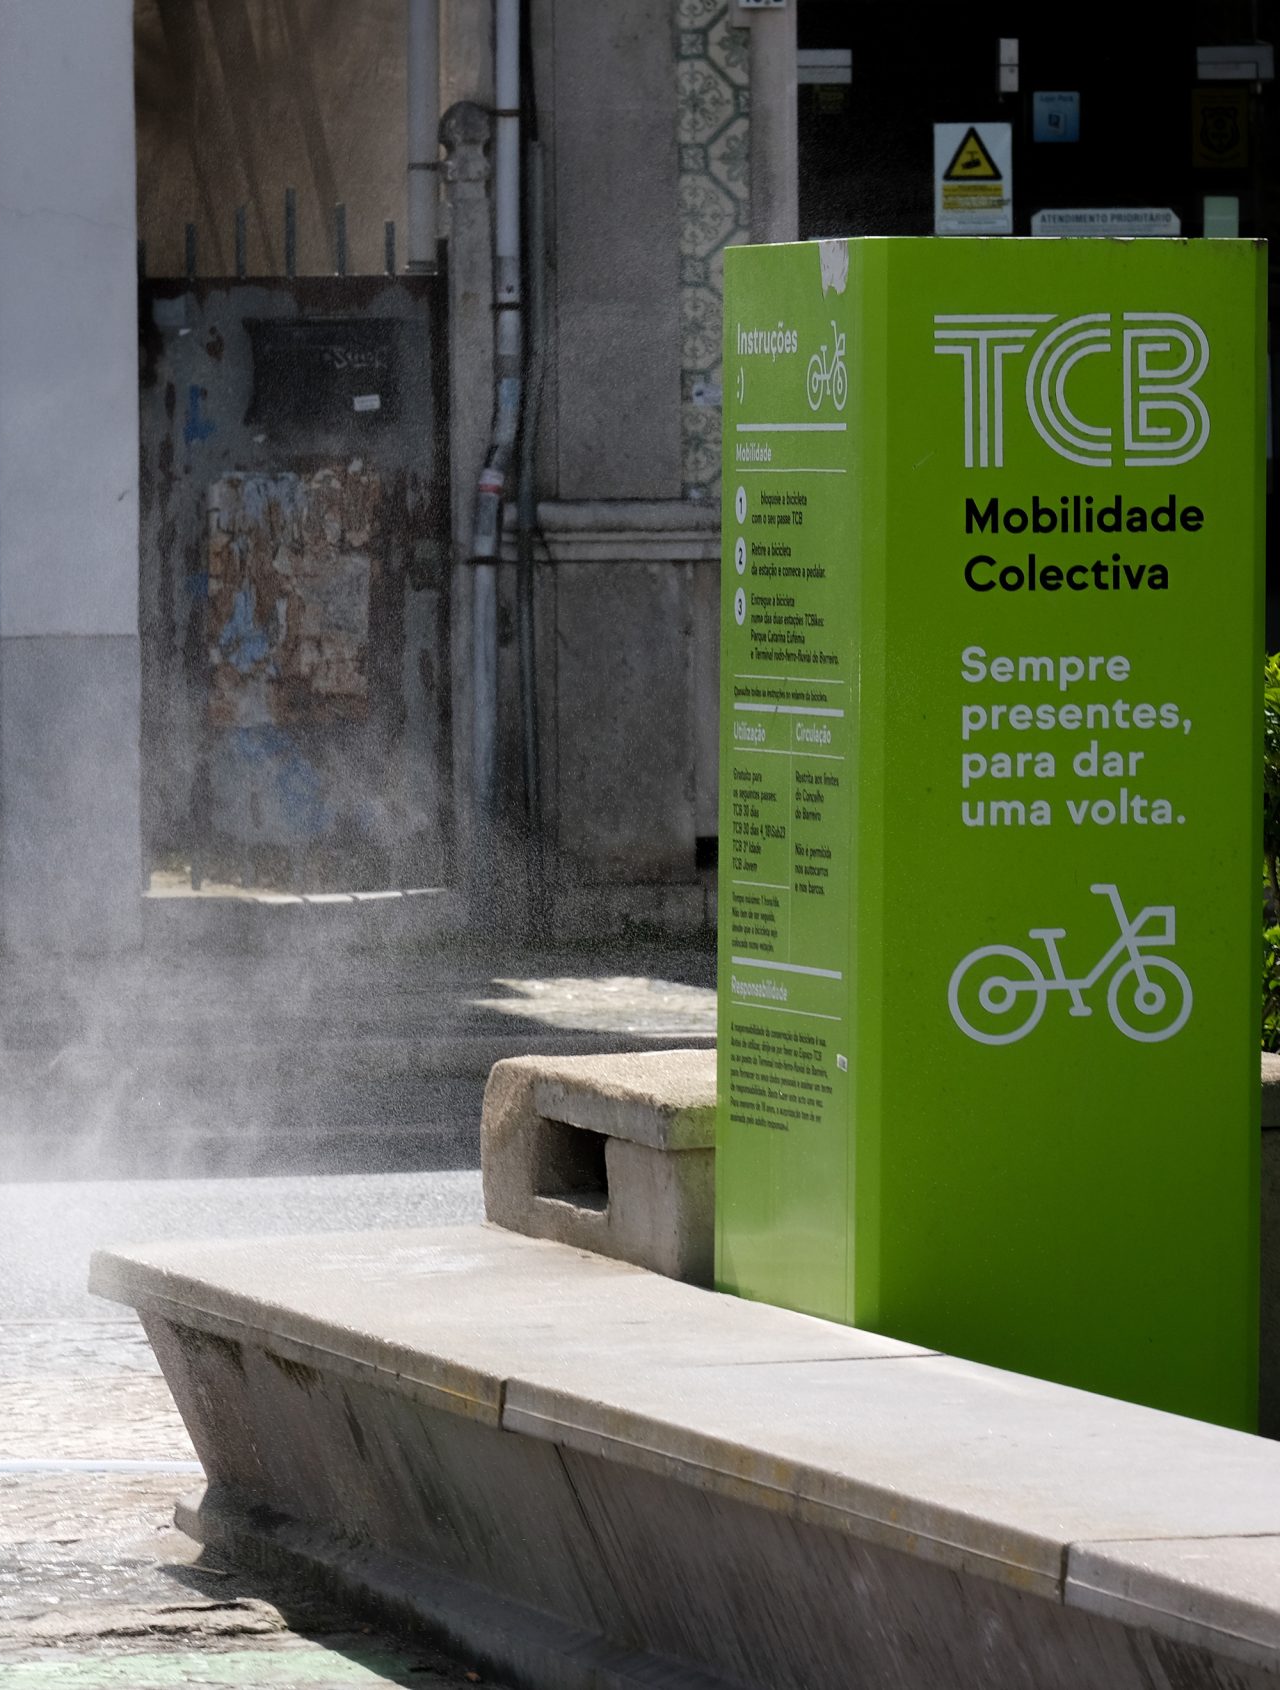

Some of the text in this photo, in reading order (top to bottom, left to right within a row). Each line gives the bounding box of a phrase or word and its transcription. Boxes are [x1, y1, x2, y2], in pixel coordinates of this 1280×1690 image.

[737, 320, 798, 362] Instruções
[933, 312, 1211, 468] TCB
[736, 443, 772, 462] Mobilidade
[739, 496, 742, 514] 1
[965, 494, 1204, 534] Mobilidade
[752, 511, 803, 528] com o seu passe TCB
[738, 546, 743, 566] 2
[752, 542, 792, 557] Retire a bicicleta
[964, 553, 1168, 592] Colectiva
[738, 598, 743, 616] 3
[960, 646, 1130, 692] Sempre
[734, 720, 766, 745] Utilização
[961, 699, 1192, 740] presentes,
[796, 722, 832, 747] Circulação
[961, 740, 1144, 788] para dar
[961, 787, 1186, 827] uma volta.
[732, 974, 788, 1001] Responsabilidade
